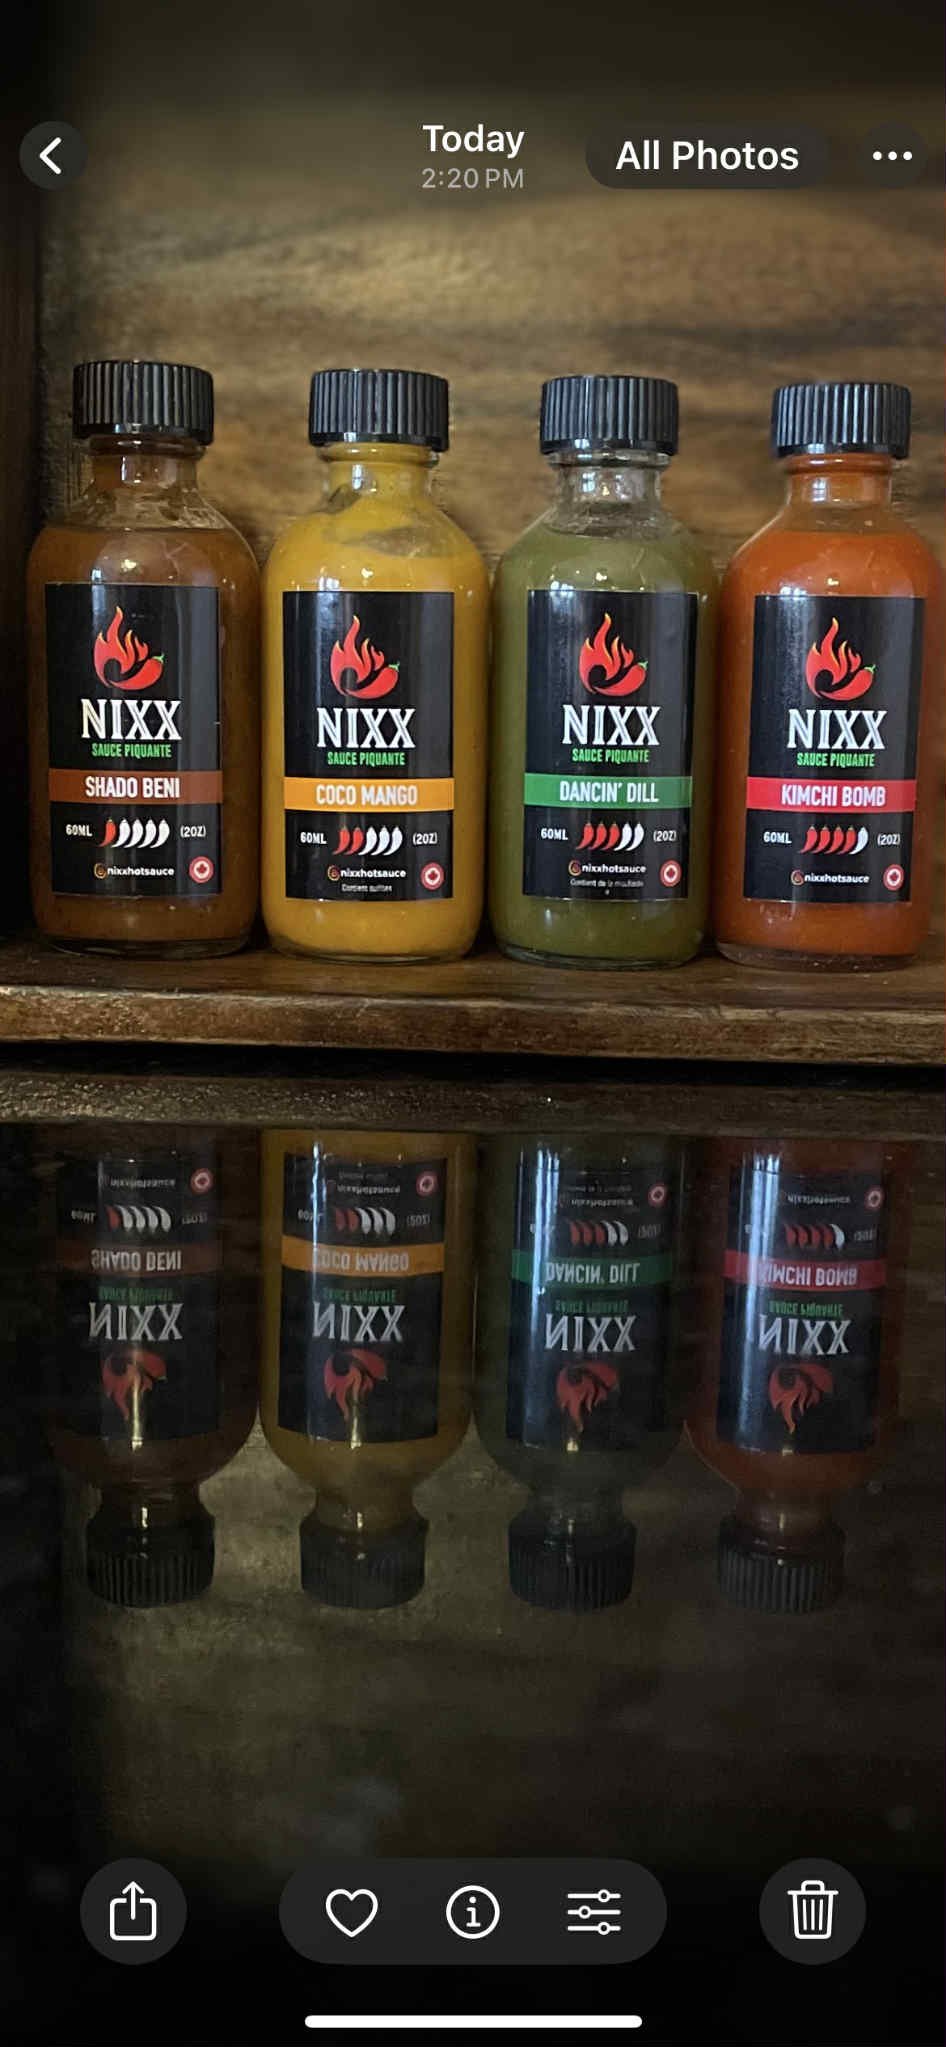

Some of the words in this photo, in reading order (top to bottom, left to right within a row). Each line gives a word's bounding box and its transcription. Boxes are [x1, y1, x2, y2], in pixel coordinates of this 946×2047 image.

[81, 699, 182, 740] NIXX
[317, 707, 416, 748] NIXX
[562, 704, 661, 745] NIXX
[787, 709, 887, 749] NIXX
[92, 743, 122, 757] SAUCE
[125, 744, 172, 759] PIQUANTE
[328, 752, 356, 765] SAUCE
[360, 753, 405, 766] PIQUANTE
[572, 748, 602, 762] SAUCE
[605, 749, 649, 764] PIQUANTE
[797, 753, 827, 766] SAUCE
[831, 753, 875, 768] PIQUANTE
[85, 776, 137, 797] SHADO
[143, 778, 180, 798] BENI
[316, 785, 356, 805] COCO
[361, 785, 417, 806] MANGO
[560, 781, 622, 802] DANCIN'
[627, 783, 659, 803] DILL
[782, 784, 837, 806] KIMCHI
[842, 787, 886, 806] BOMB
[66, 824, 92, 836] 60ML
[300, 832, 327, 844] 60ML
[541, 828, 568, 840] 60ML
[764, 832, 792, 844] 60ML
